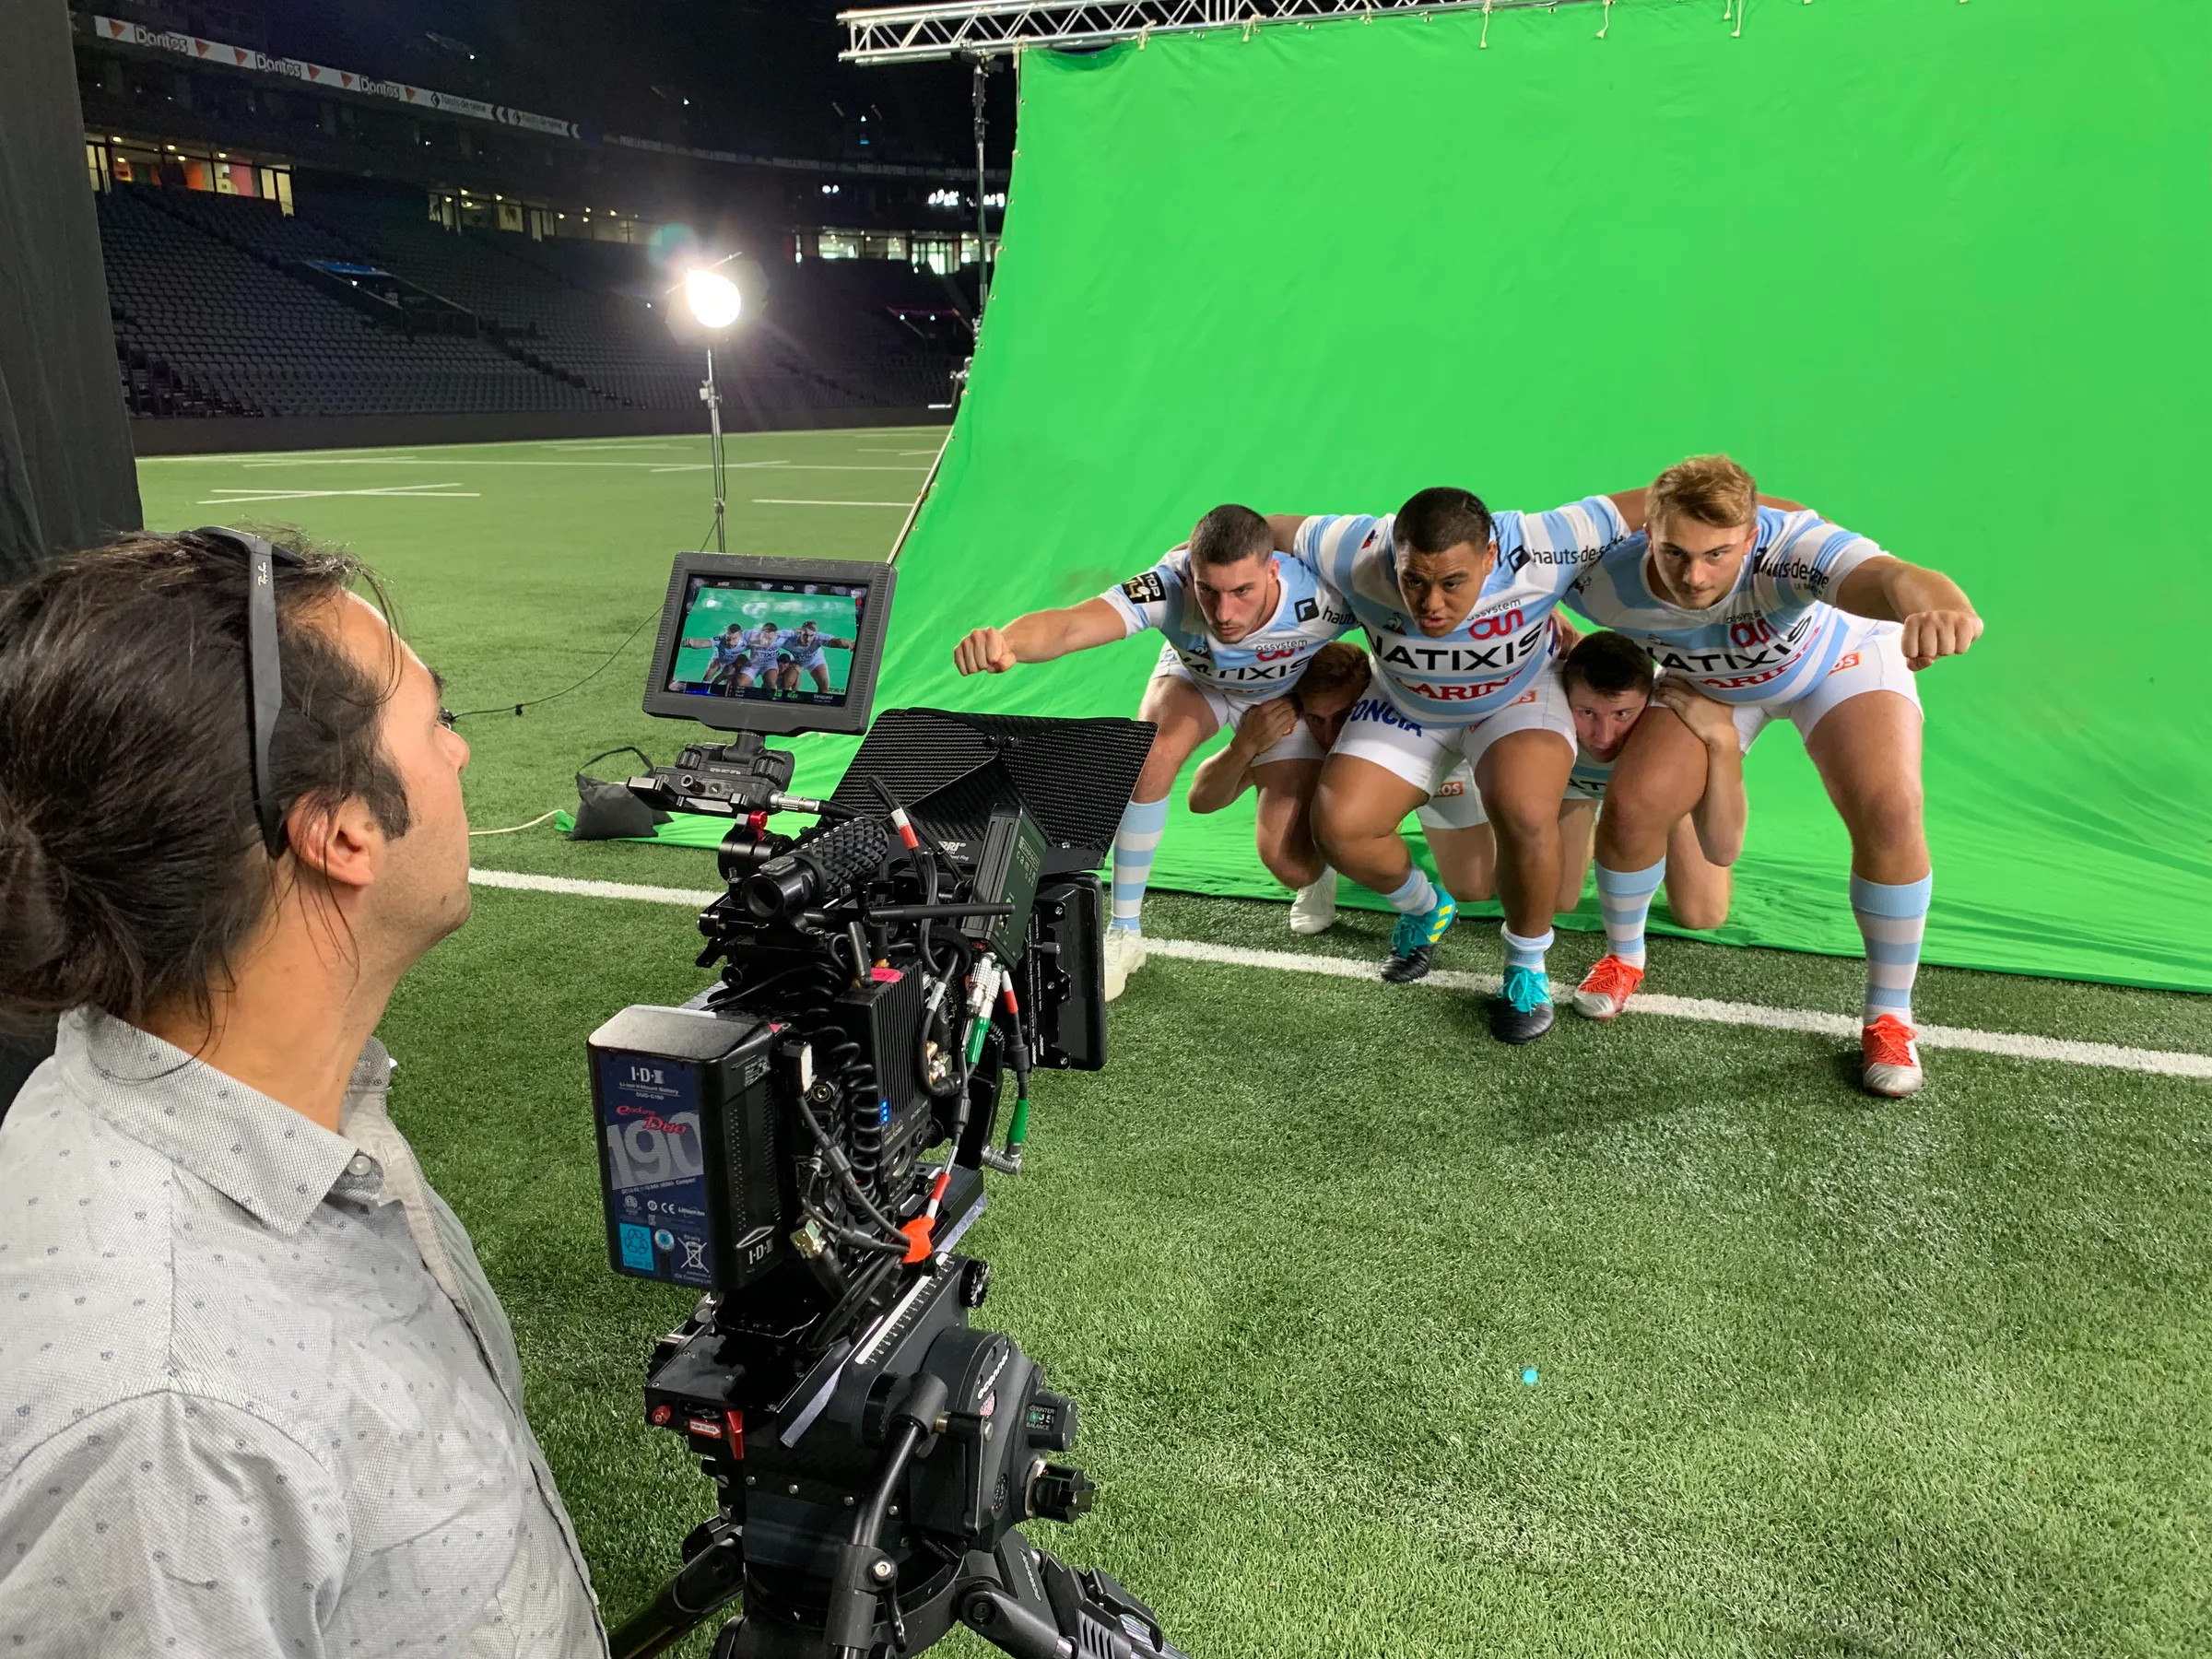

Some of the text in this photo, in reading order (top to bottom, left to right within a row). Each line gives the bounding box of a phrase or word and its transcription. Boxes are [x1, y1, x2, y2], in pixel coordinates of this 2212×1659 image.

[135, 25, 188, 54] Doritos
[256, 52, 301, 77] Doritos
[1145, 573, 1161, 597] TOP
[937, 841, 960, 852] RRI
[606, 1112, 704, 1188] 190
[1030, 1405, 1055, 1414] COUNTER
[1026, 1422, 1051, 1431] BALANCE
